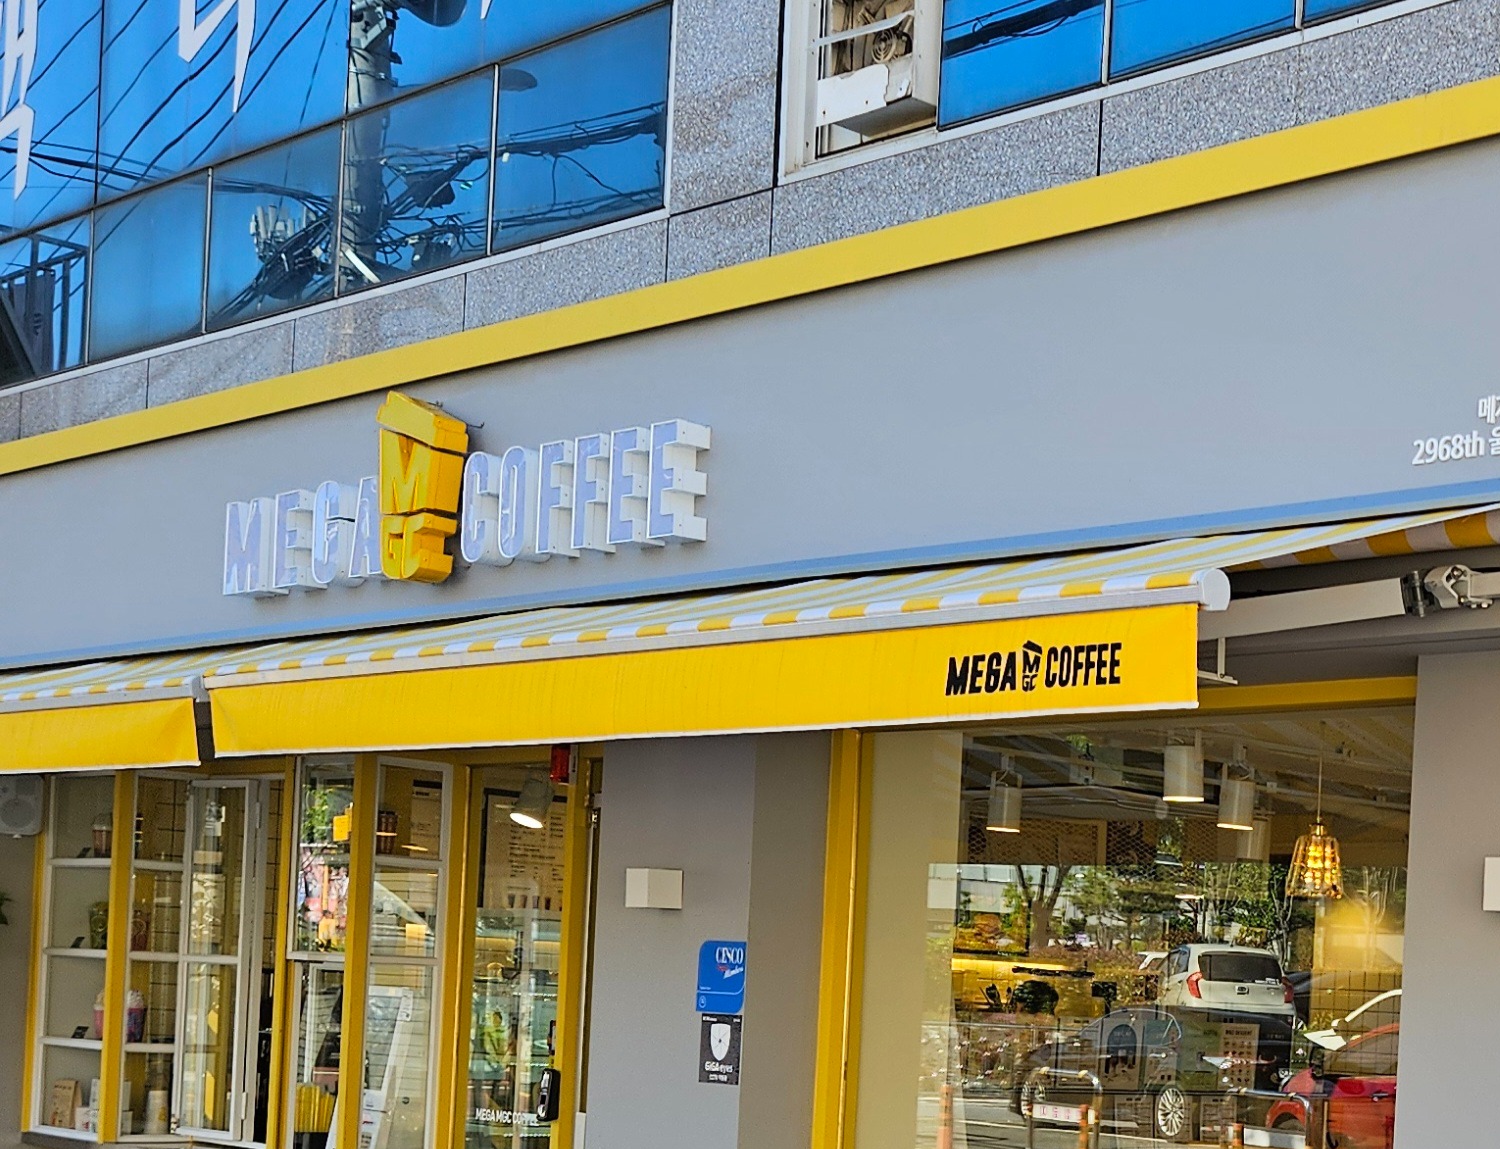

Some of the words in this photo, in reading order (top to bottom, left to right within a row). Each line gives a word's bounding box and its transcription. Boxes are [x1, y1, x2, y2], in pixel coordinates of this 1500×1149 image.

[1412, 430, 1485, 465] 2968th
[222, 475, 381, 597] MEGA
[460, 418, 711, 566] COFFEE
[945, 651, 1016, 696] MEGA
[1044, 642, 1122, 689] COFFEE
[475, 1108, 495, 1121] MEGA
[496, 1110, 512, 1123] MGC
